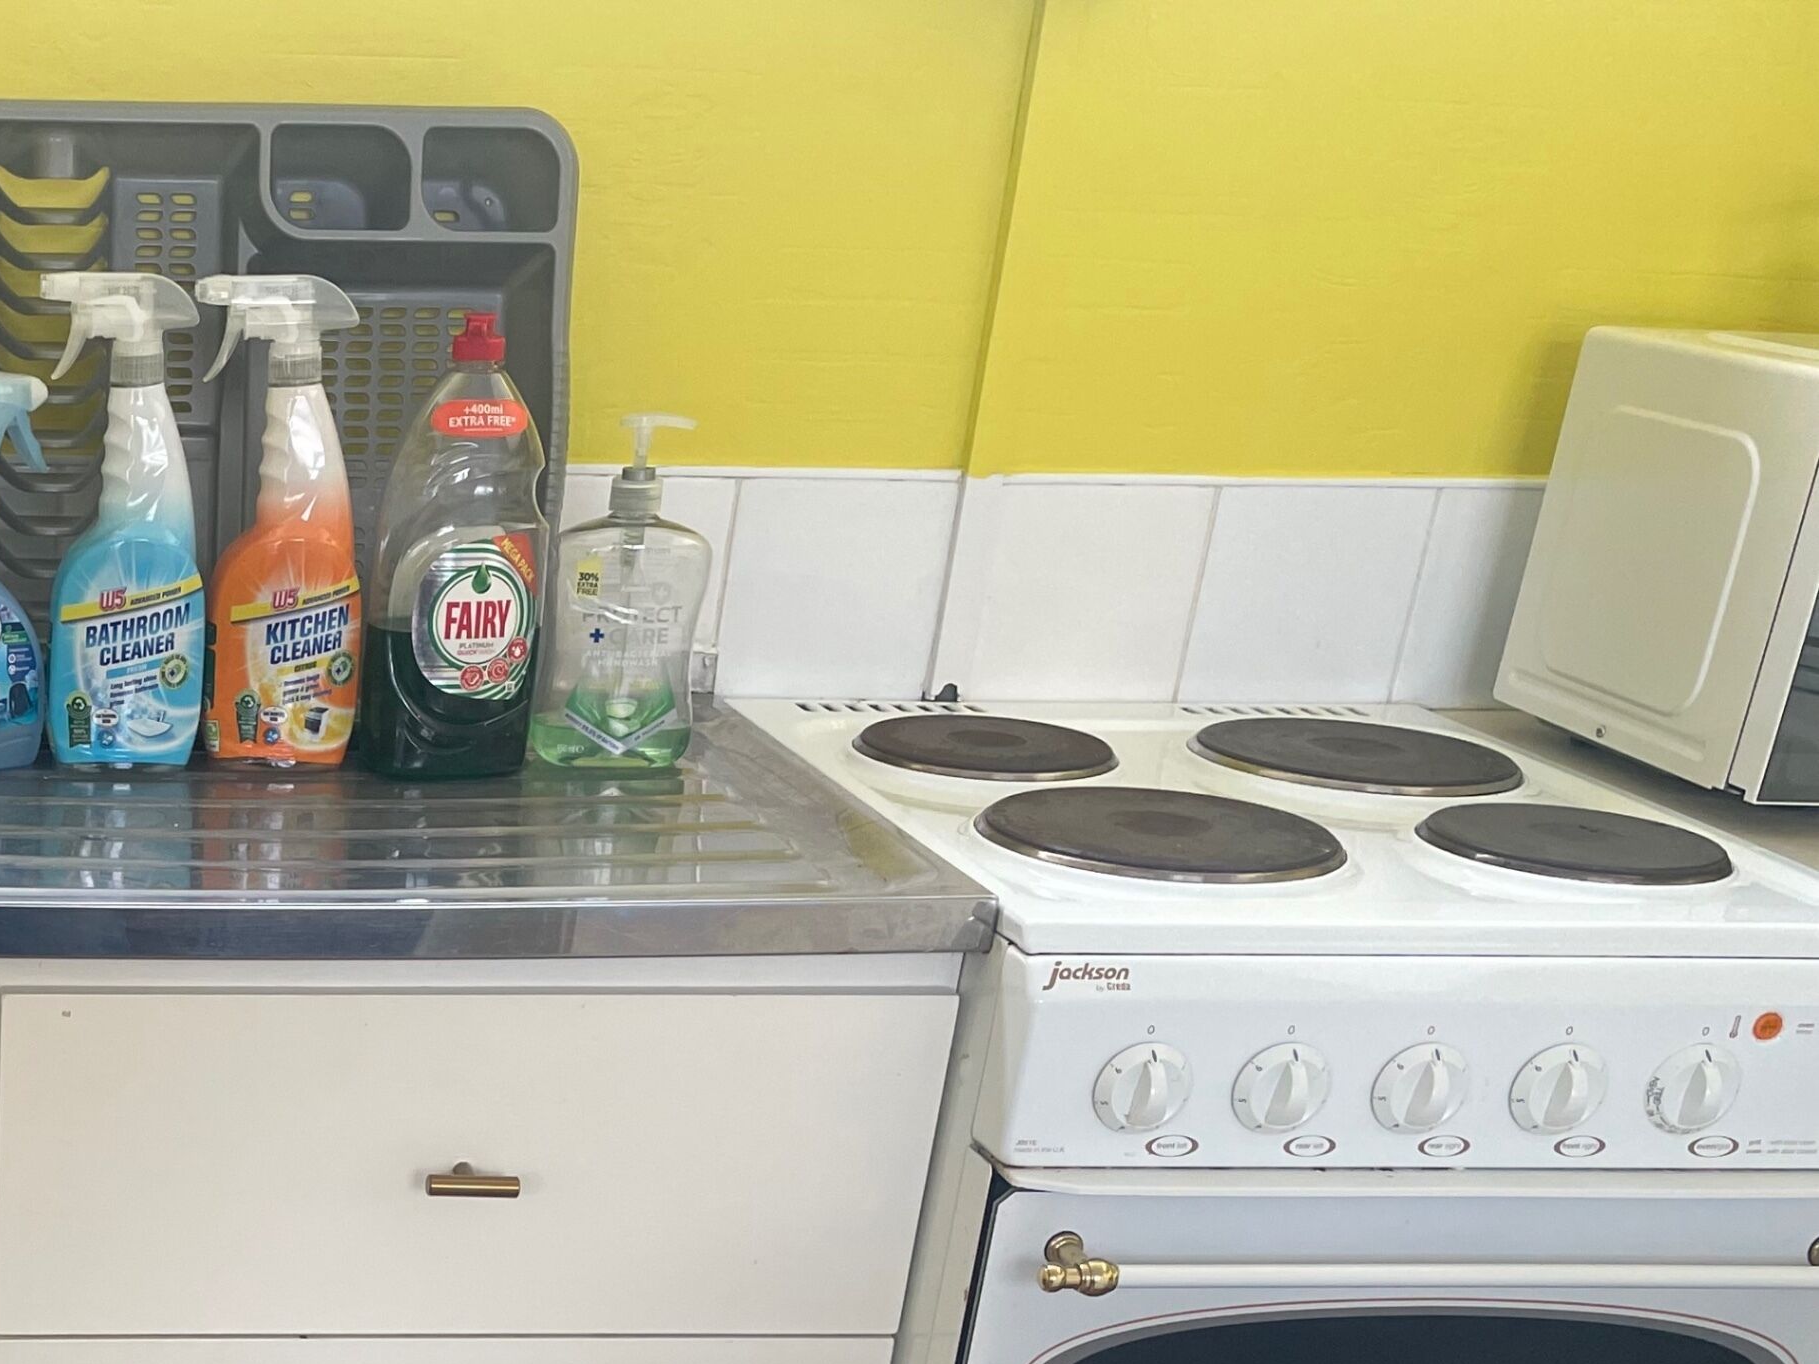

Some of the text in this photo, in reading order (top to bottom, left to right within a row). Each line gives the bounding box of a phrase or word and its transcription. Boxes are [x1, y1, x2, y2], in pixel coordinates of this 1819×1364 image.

[449, 416, 485, 428] EXTRA
[464, 404, 504, 415] +400ml
[501, 537, 535, 583] MEGA PACK
[576, 588, 598, 596] FREE
[577, 572, 599, 581] 30%
[85, 602, 191, 648] BATHROOM
[266, 603, 350, 646] KITCHEN
[443, 600, 512, 640] FAIRY
[609, 627, 669, 645] CARE
[99, 632, 175, 667] CLEANER
[270, 631, 342, 665] CLEANER
[1042, 961, 1130, 991] jackson
